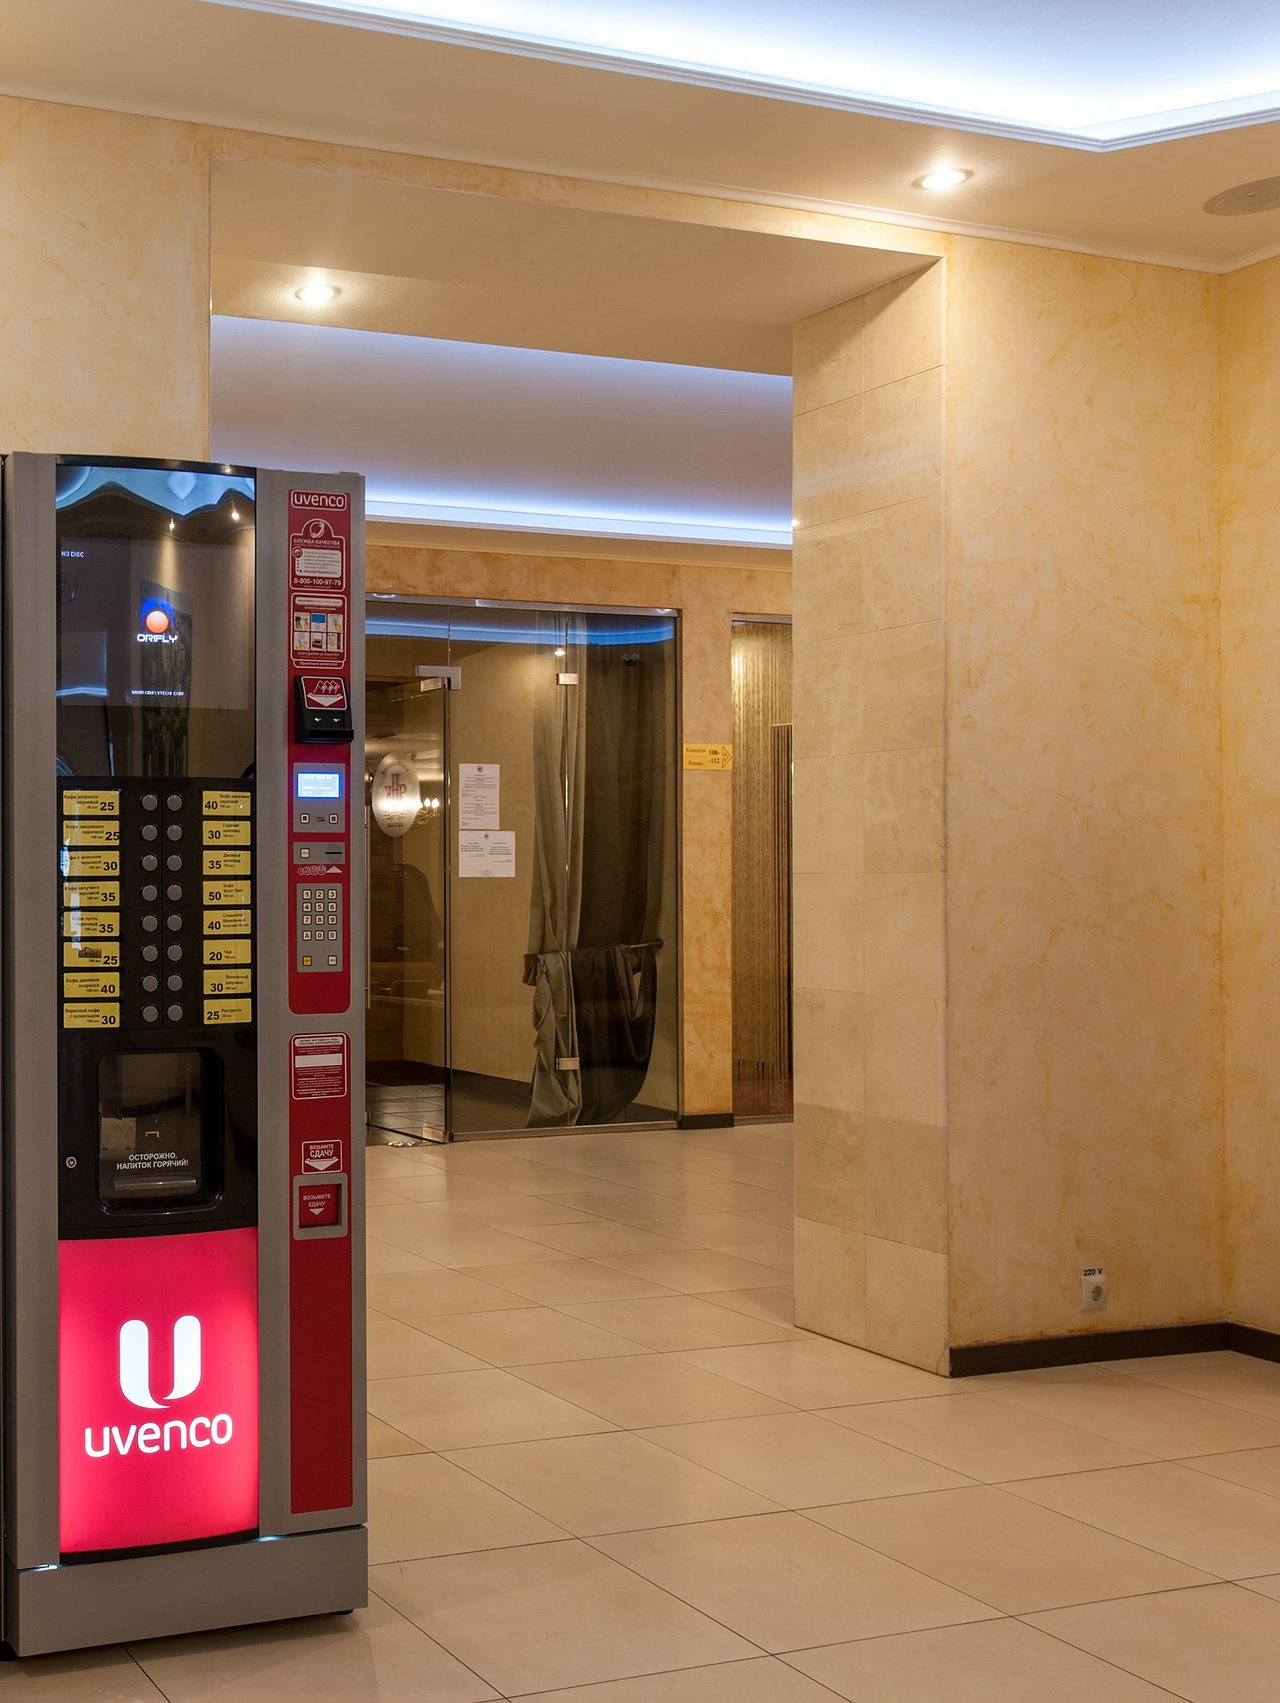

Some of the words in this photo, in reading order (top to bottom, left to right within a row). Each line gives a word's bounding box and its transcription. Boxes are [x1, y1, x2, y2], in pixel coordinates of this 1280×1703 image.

[294, 494, 344, 507] uvenco
[137, 634, 177, 643] ORIFLY
[100, 802, 114, 810] 25
[205, 801, 217, 810] 40
[105, 832, 119, 840] 25
[208, 831, 220, 839] 30
[103, 862, 117, 870] 30
[208, 860, 221, 869] 35
[101, 892, 115, 901] 35
[208, 892, 221, 900] 50
[99, 924, 114, 933] 35
[208, 921, 221, 930] 40
[103, 956, 117, 965] 25
[209, 952, 222, 961] 20
[101, 985, 115, 993] 40
[210, 983, 223, 992] 30
[101, 1016, 116, 1024] 30
[207, 1011, 220, 1020] 25
[310, 1149, 334, 1158] СДАЧУ
[117, 1161, 152, 1170] НАПИТОК
[153, 1158, 189, 1168] ГОРЯЧИЙ!
[85, 1413, 233, 1458] uvenco
